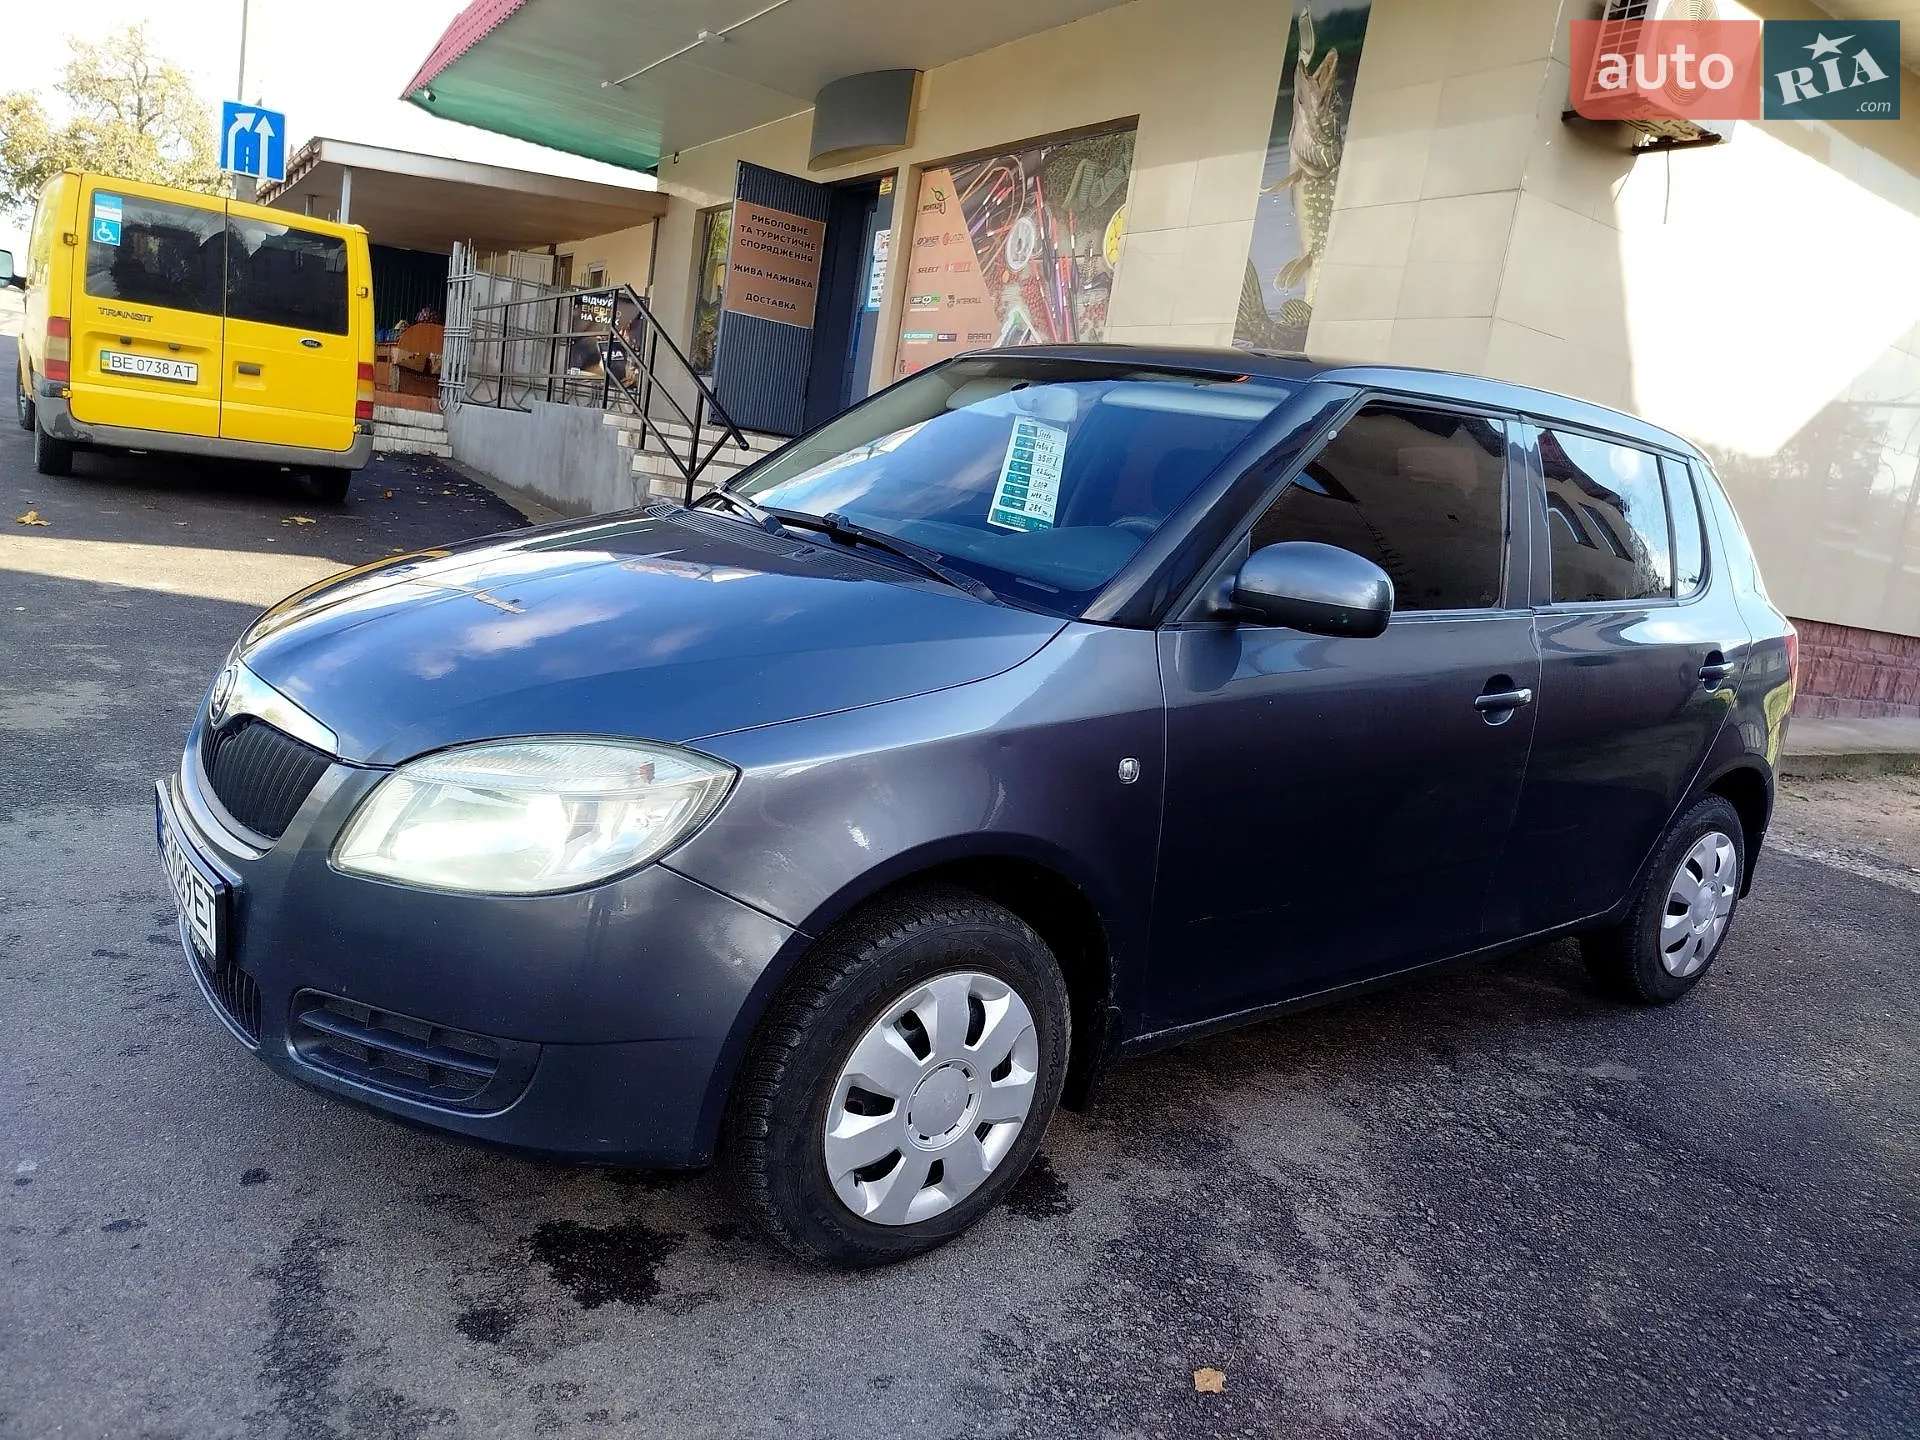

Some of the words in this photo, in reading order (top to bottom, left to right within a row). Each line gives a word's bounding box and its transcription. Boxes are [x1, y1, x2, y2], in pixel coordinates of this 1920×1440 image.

[751, 214, 809, 236] РИБОЛОВНЕ
[740, 224, 753, 235] ТА
[755, 228, 817, 251] ТУРИСТИЧНЕ
[740, 238, 813, 263] СПОРЯДЖЕННЯ
[733, 263, 763, 278] ЖИВА
[766, 271, 813, 289] НАЖИВКА
[745, 292, 797, 311] ДОСТАВКА
[98, 307, 154, 322] TRANSIT
[581, 313, 593, 322] НА
[111, 355, 133, 370] BE
[136, 359, 170, 375] 0738
[173, 365, 194, 378] AT
[192, 874, 215, 941] ET
